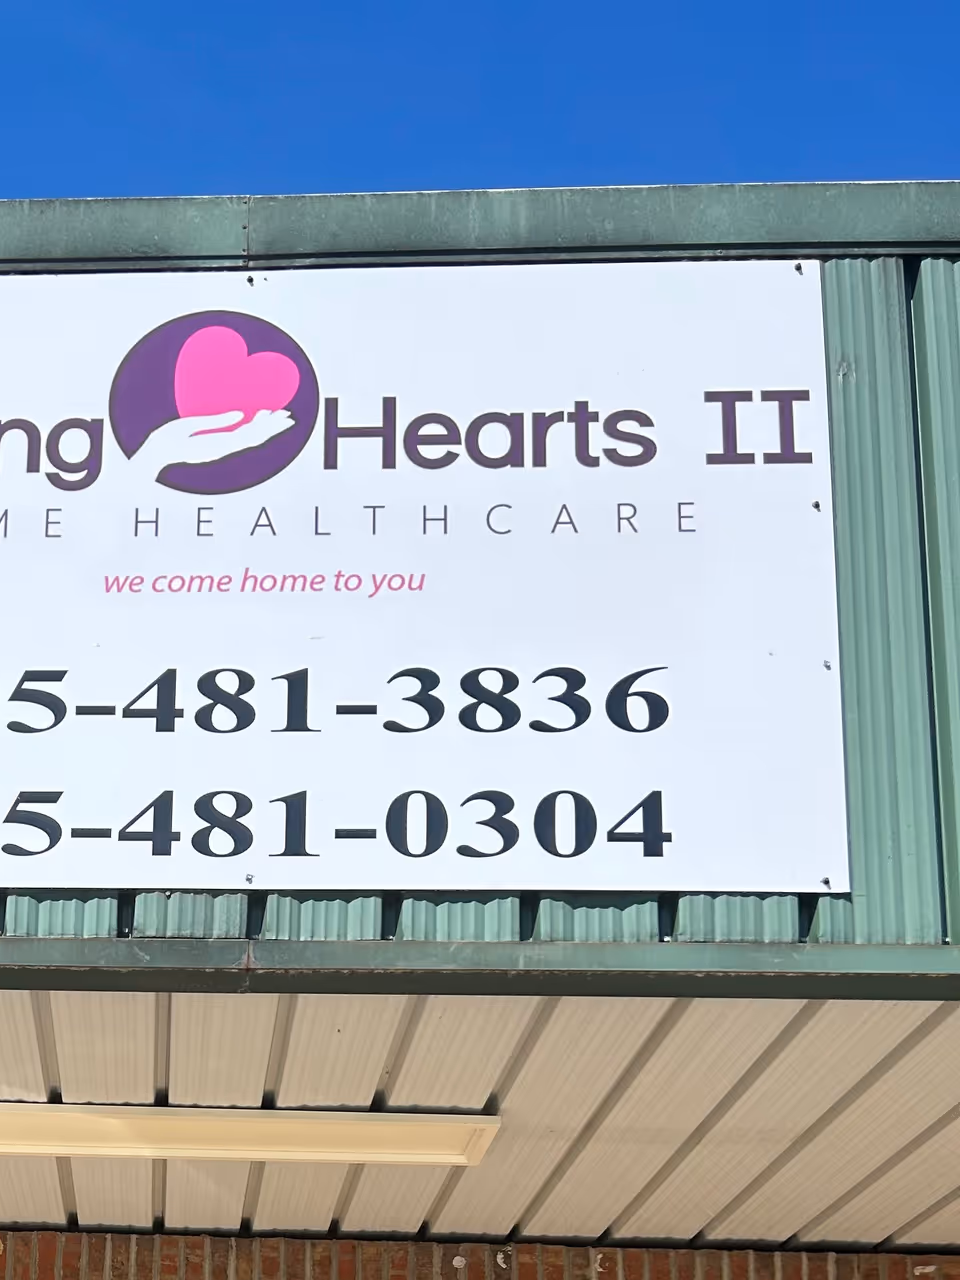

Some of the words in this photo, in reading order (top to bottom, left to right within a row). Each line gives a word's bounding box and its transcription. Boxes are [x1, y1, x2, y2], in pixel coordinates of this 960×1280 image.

[323, 396, 658, 471] Hearts
[703, 389, 813, 465] II
[133, 501, 697, 538] HEALTHCARE
[104, 575, 145, 594] we
[151, 574, 233, 593] come
[239, 566, 326, 593] home
[333, 569, 363, 592] to
[367, 573, 426, 599] you
